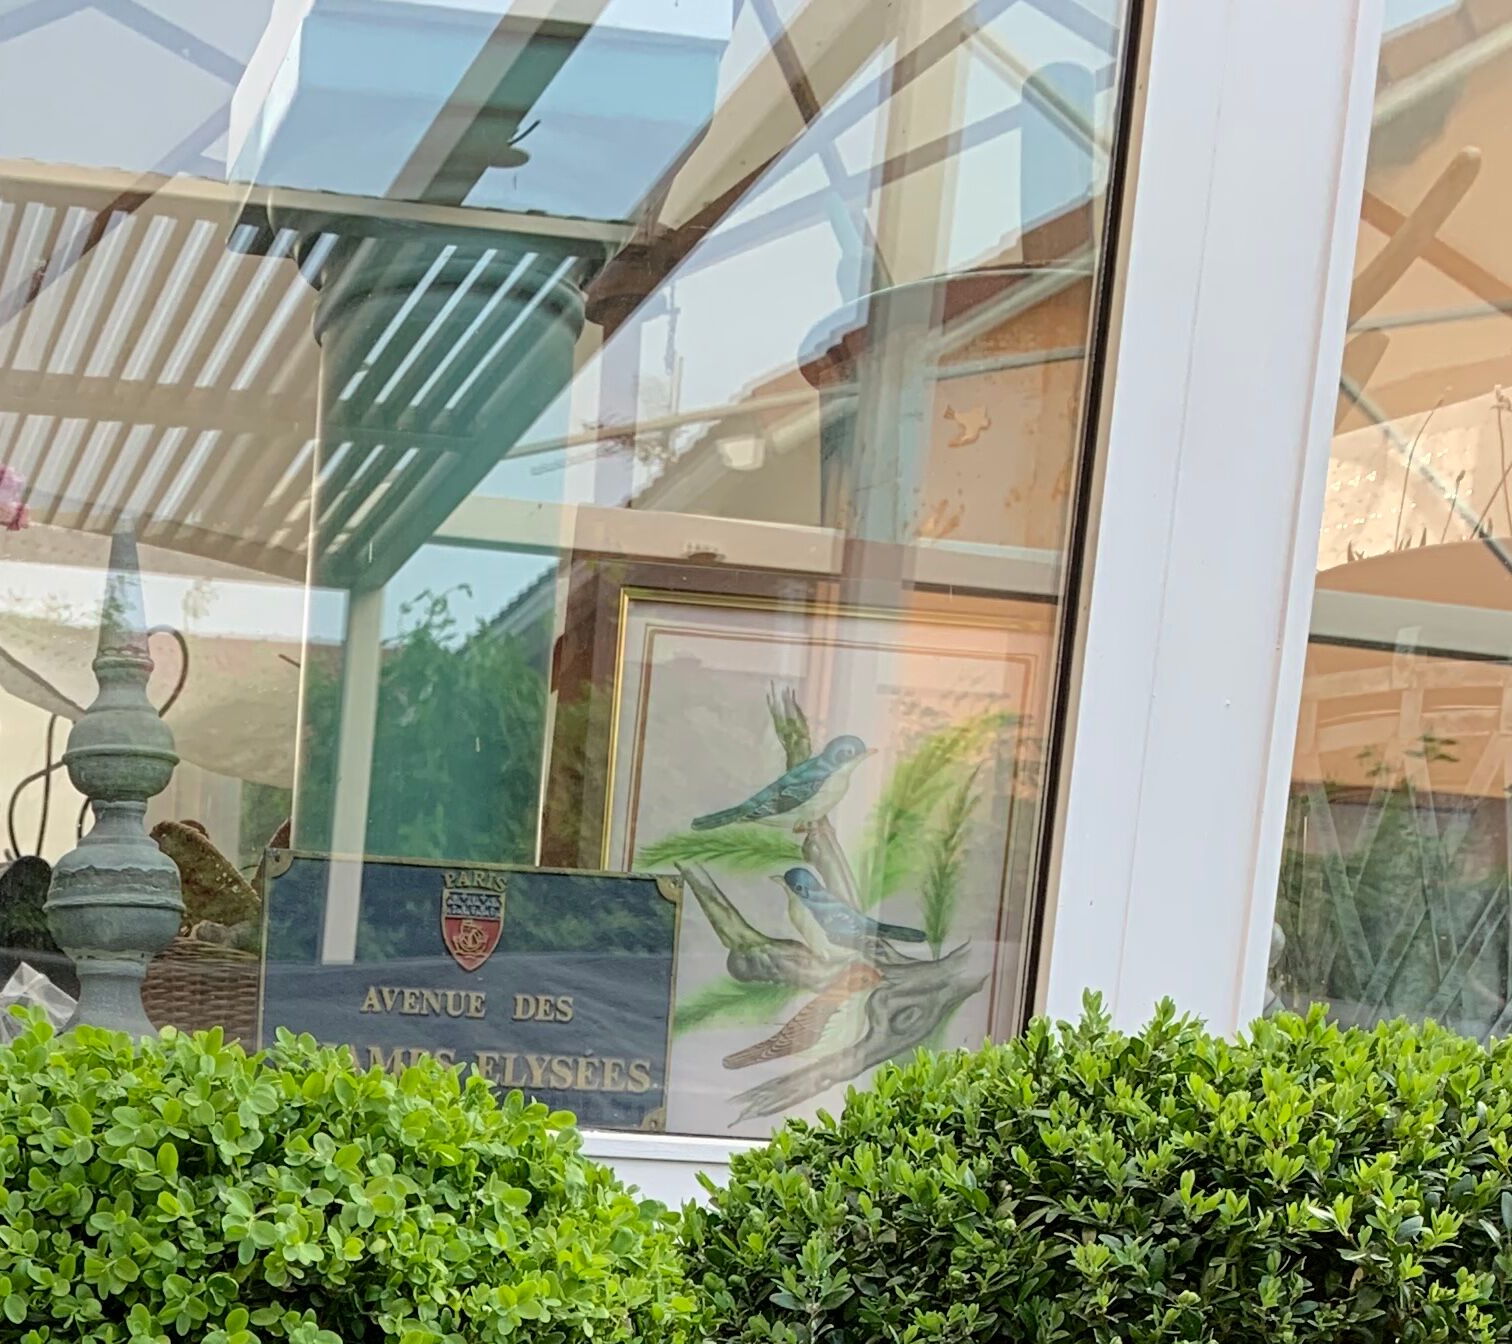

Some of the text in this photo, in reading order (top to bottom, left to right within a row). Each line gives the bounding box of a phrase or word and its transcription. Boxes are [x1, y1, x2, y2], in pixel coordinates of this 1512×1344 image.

[443, 871, 507, 893] PARIS
[360, 986, 574, 1023] AVENUE DES
